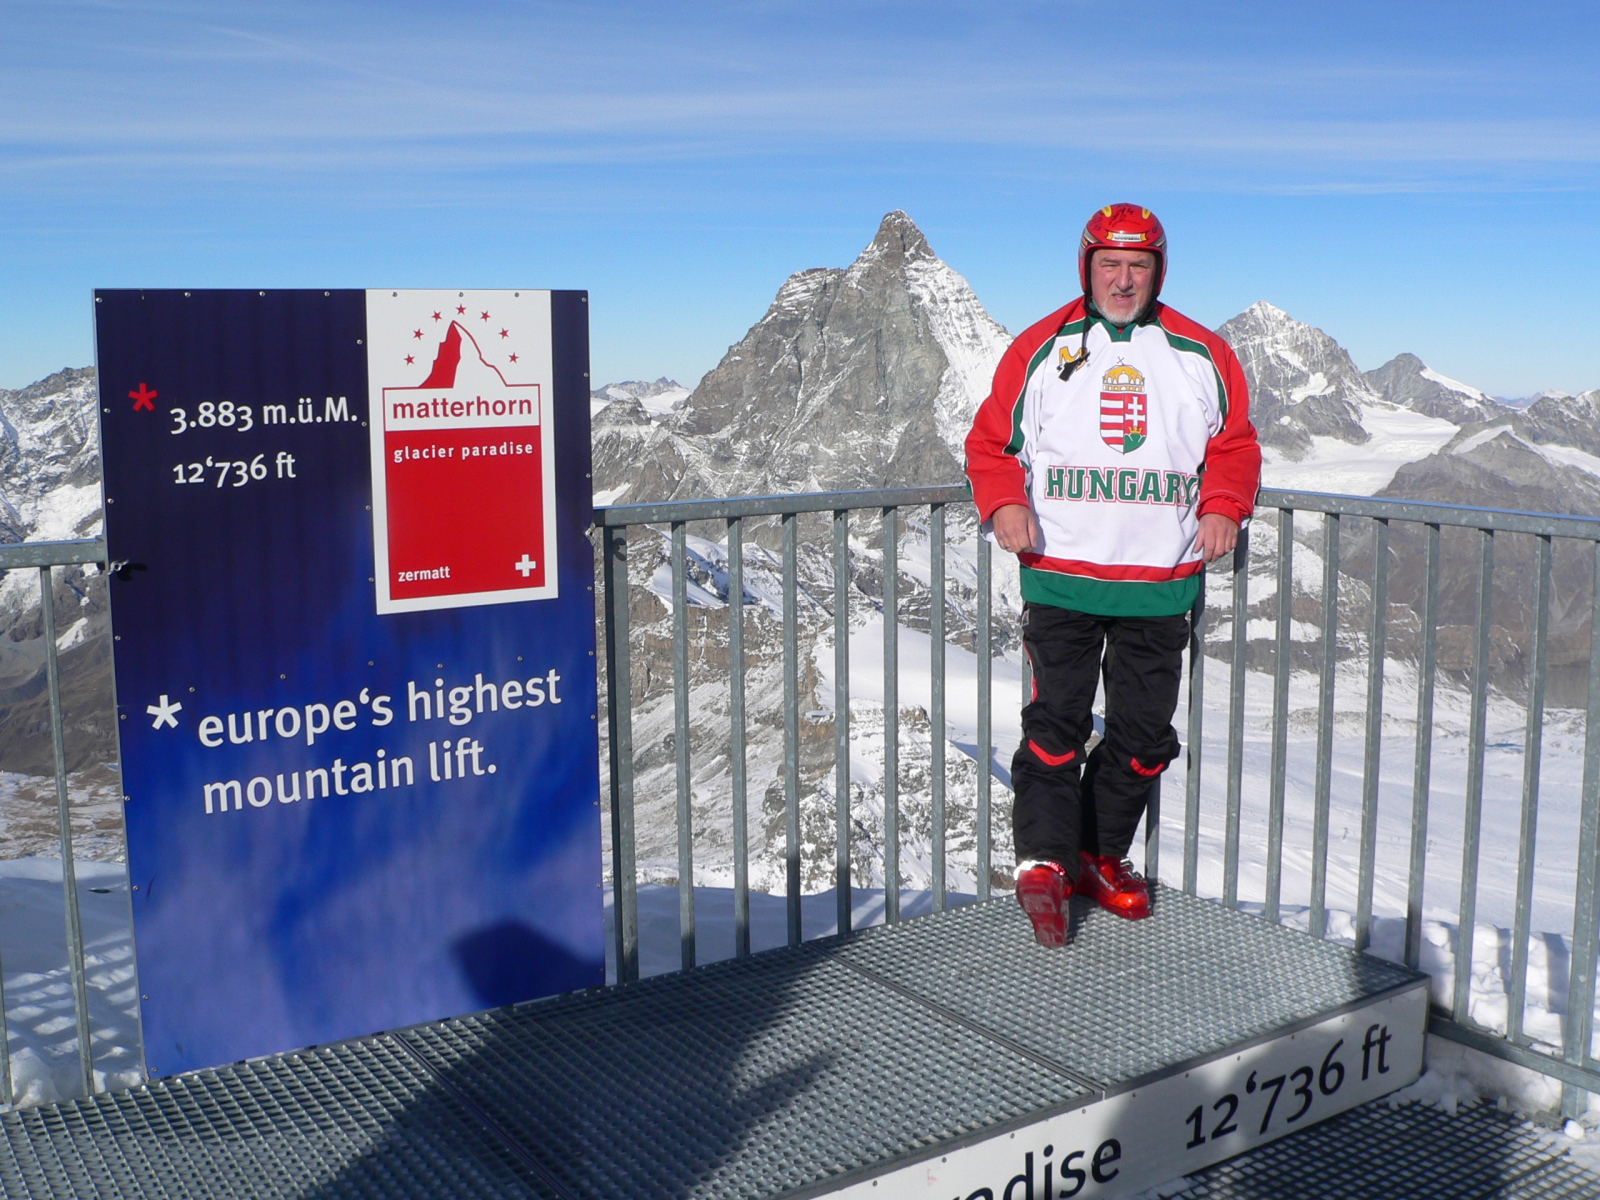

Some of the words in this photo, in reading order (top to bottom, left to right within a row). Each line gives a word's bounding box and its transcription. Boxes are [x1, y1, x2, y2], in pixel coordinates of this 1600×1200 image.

[170, 401, 254, 434] 3.883
[263, 397, 358, 424] m.ü.M.
[393, 396, 532, 419] matterhorn
[276, 452, 297, 479] ft
[394, 445, 454, 463] glacier
[462, 441, 533, 460] paradise
[1044, 465, 1200, 507] HUNGARY
[398, 566, 451, 582] zermatt
[198, 687, 393, 747] europe‘s
[407, 669, 562, 726] highest
[203, 749, 415, 815] mountain
[429, 738, 498, 782] lift.
[1362, 1023, 1392, 1081] ft
